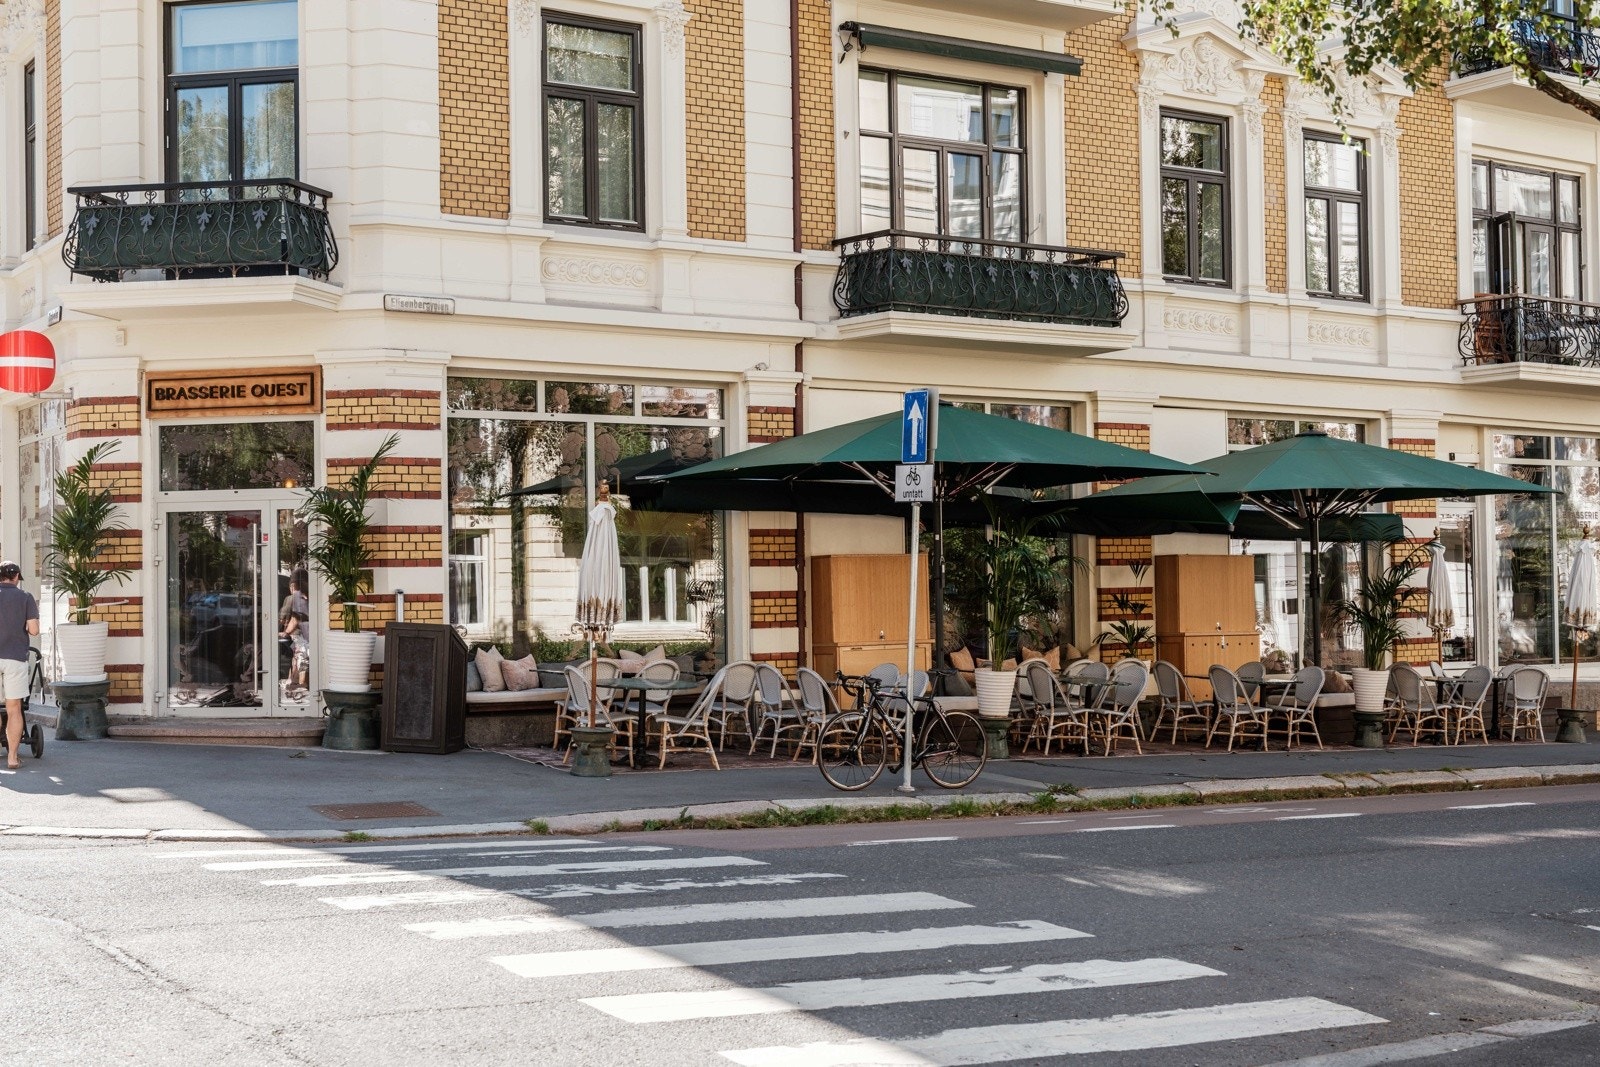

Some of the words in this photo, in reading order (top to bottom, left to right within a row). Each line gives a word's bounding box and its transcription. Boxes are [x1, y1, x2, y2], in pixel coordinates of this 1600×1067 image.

[154, 384, 247, 401] BRASSERIE
[251, 382, 308, 398] OUEST
[902, 489, 923, 499] unntatt
